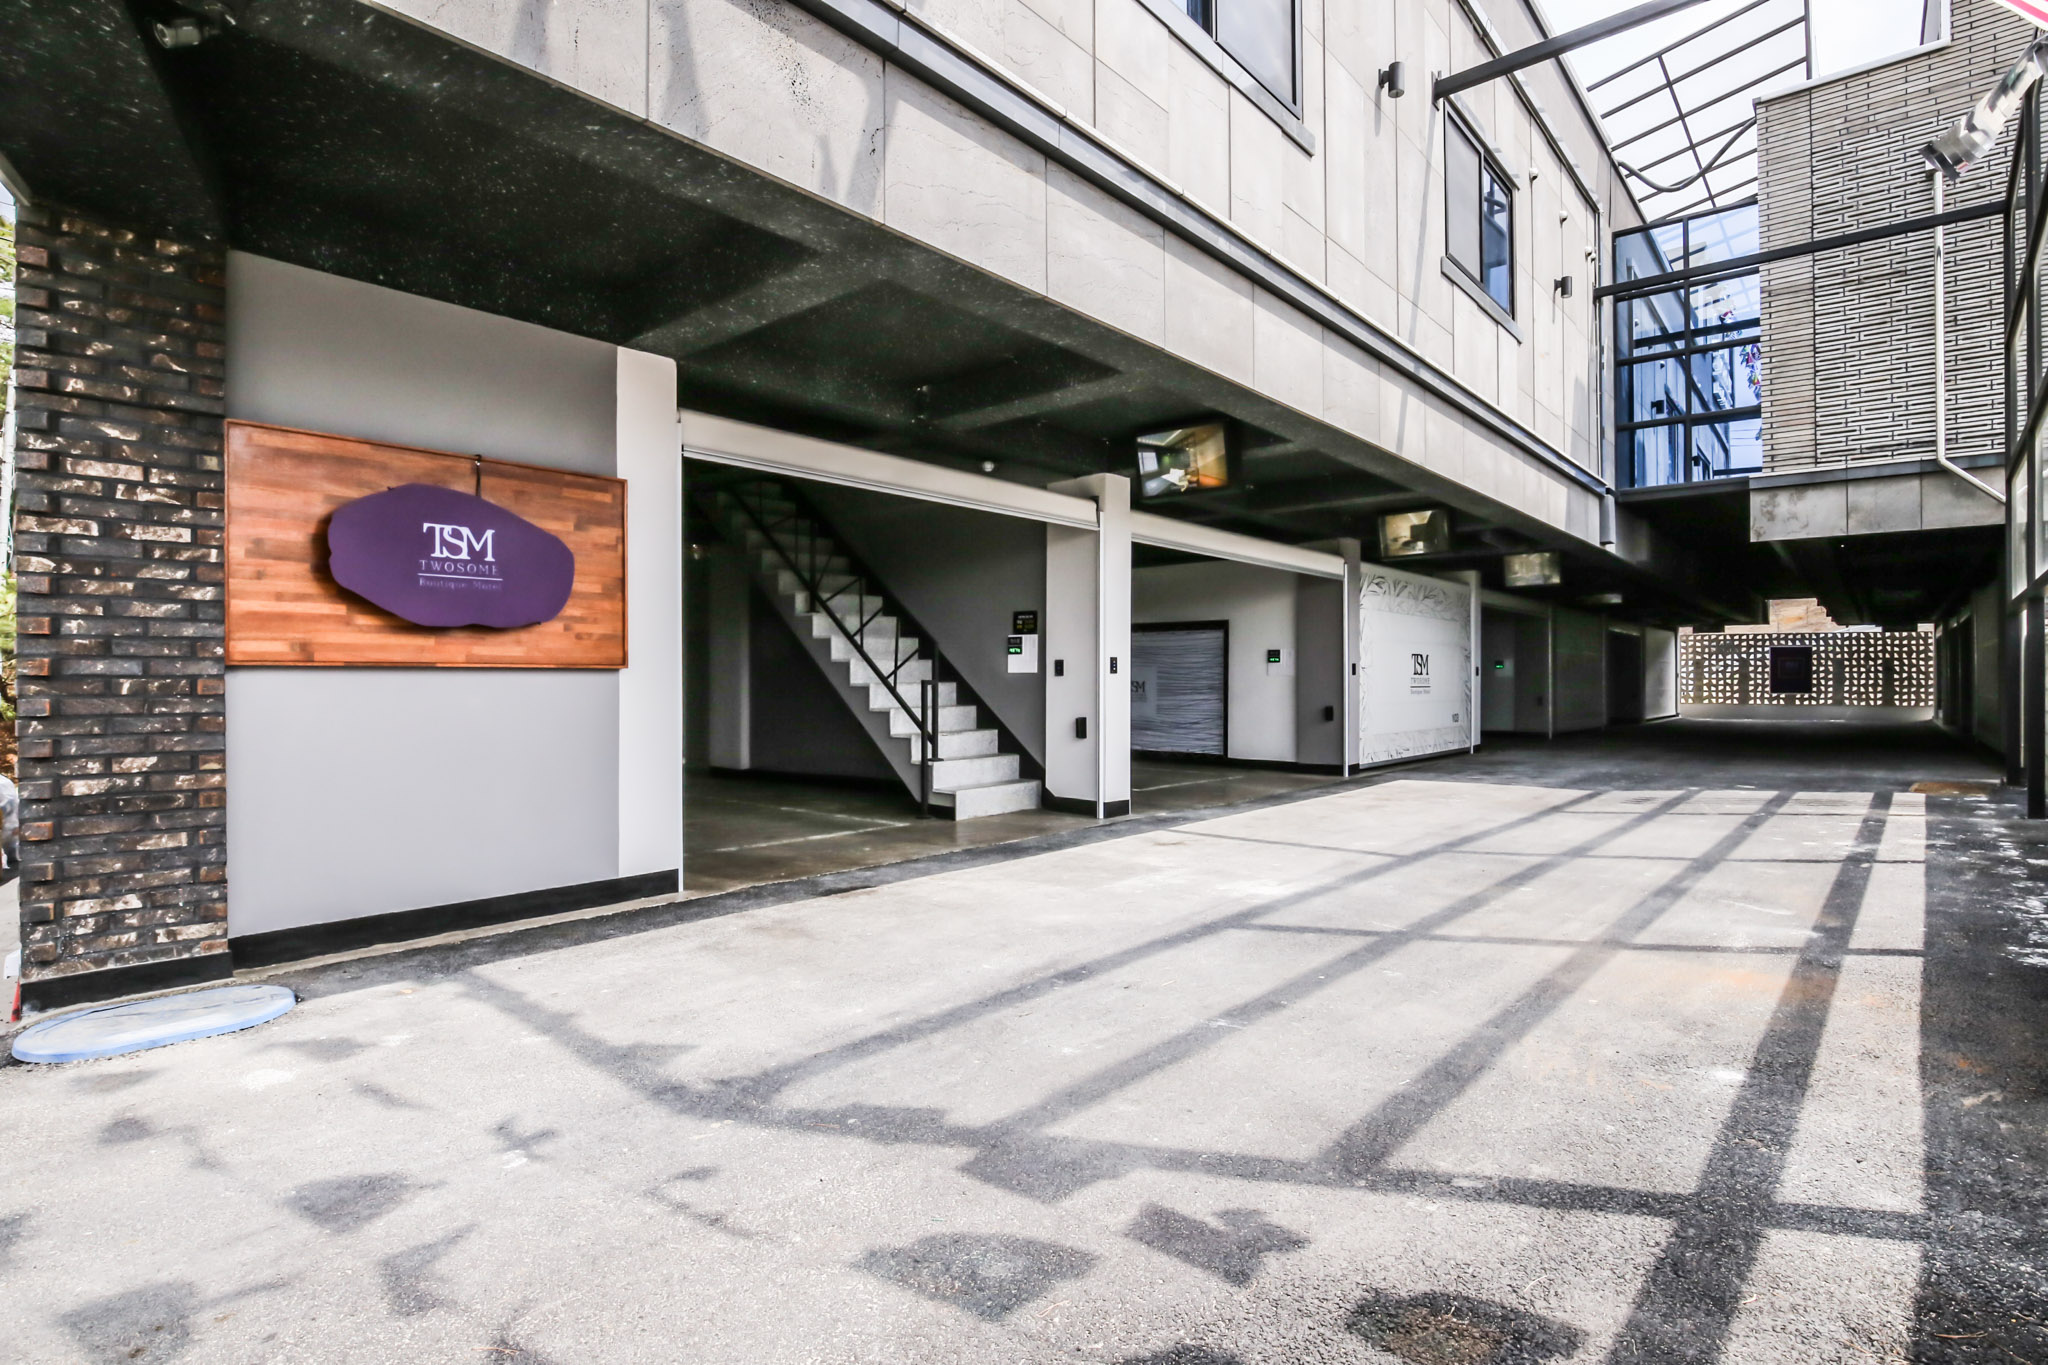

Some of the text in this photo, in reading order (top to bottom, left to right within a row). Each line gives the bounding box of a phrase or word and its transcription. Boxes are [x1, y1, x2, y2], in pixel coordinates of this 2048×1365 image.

[422, 522, 495, 562] TSM
[419, 560, 499, 575] TWOSOME
[1411, 653, 1429, 675] TSM
[1131, 680, 1145, 693] SM
